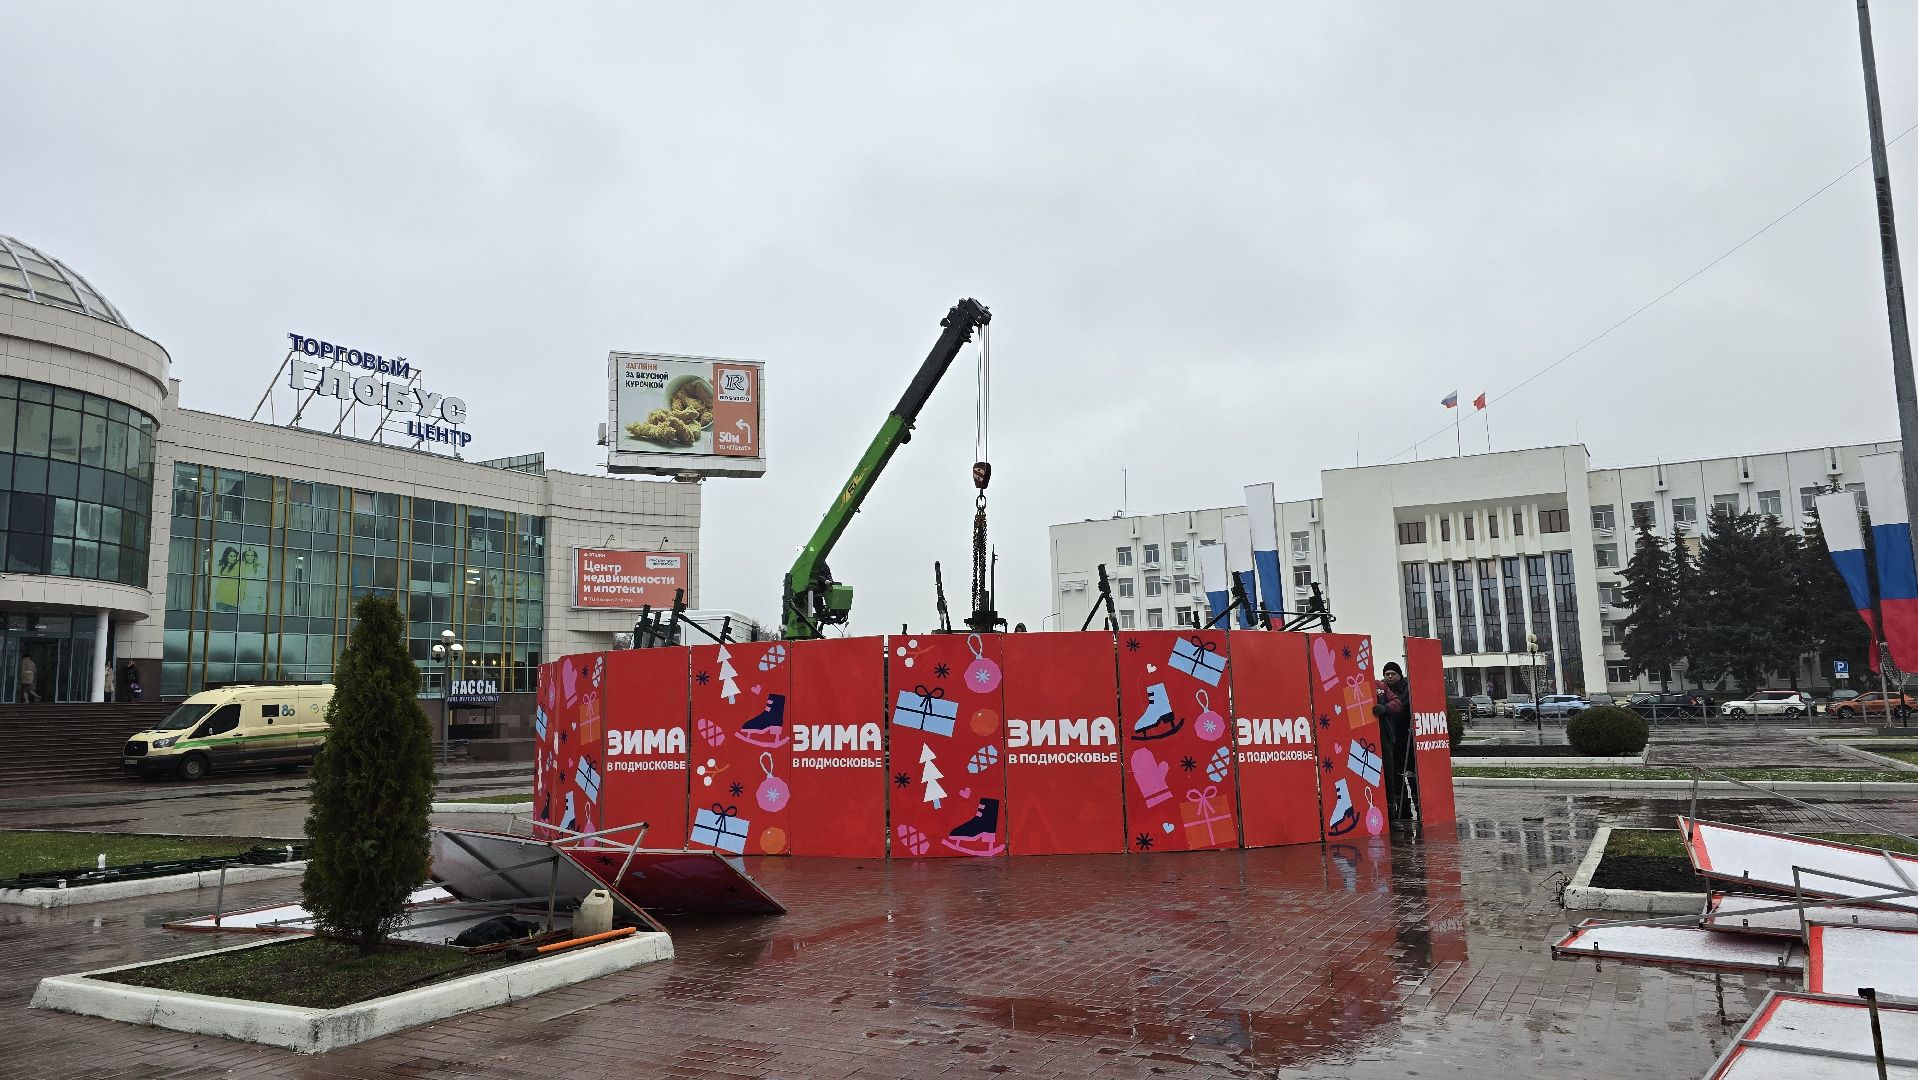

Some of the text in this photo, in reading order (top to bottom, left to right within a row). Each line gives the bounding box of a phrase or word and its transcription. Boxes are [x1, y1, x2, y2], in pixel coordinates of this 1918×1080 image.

[288, 333, 410, 379] ТОРГОВЫЙ
[625, 362, 658, 370] ЗАГЛЯНИ
[636, 371, 669, 380] ВКУСНОЙ
[625, 379, 664, 389] КУРОЧКОЙ
[290, 359, 467, 425] ГЛОБУС
[407, 420, 472, 447] ЦЕНТР
[584, 559, 622, 575] Центр
[584, 573, 675, 585] недвижимости
[584, 584, 644, 594] и ипотеки
[452, 680, 496, 695] КАССЫ
[1236, 716, 1312, 746] ЗИМА
[1414, 711, 1449, 736] ЗИМА
[792, 723, 882, 752] ЗИМА
[1007, 716, 1117, 748] ЗИМА
[607, 727, 687, 756] ЗИМА
[801, 757, 882, 769] ПОДМОСКОВЬЕ
[1019, 752, 1118, 765] ПОДМОСКОВЬЕ
[1246, 751, 1314, 764] ПОДМОСКОВЬЕ
[614, 760, 686, 773] ПОДМОСКОВЬЕ
